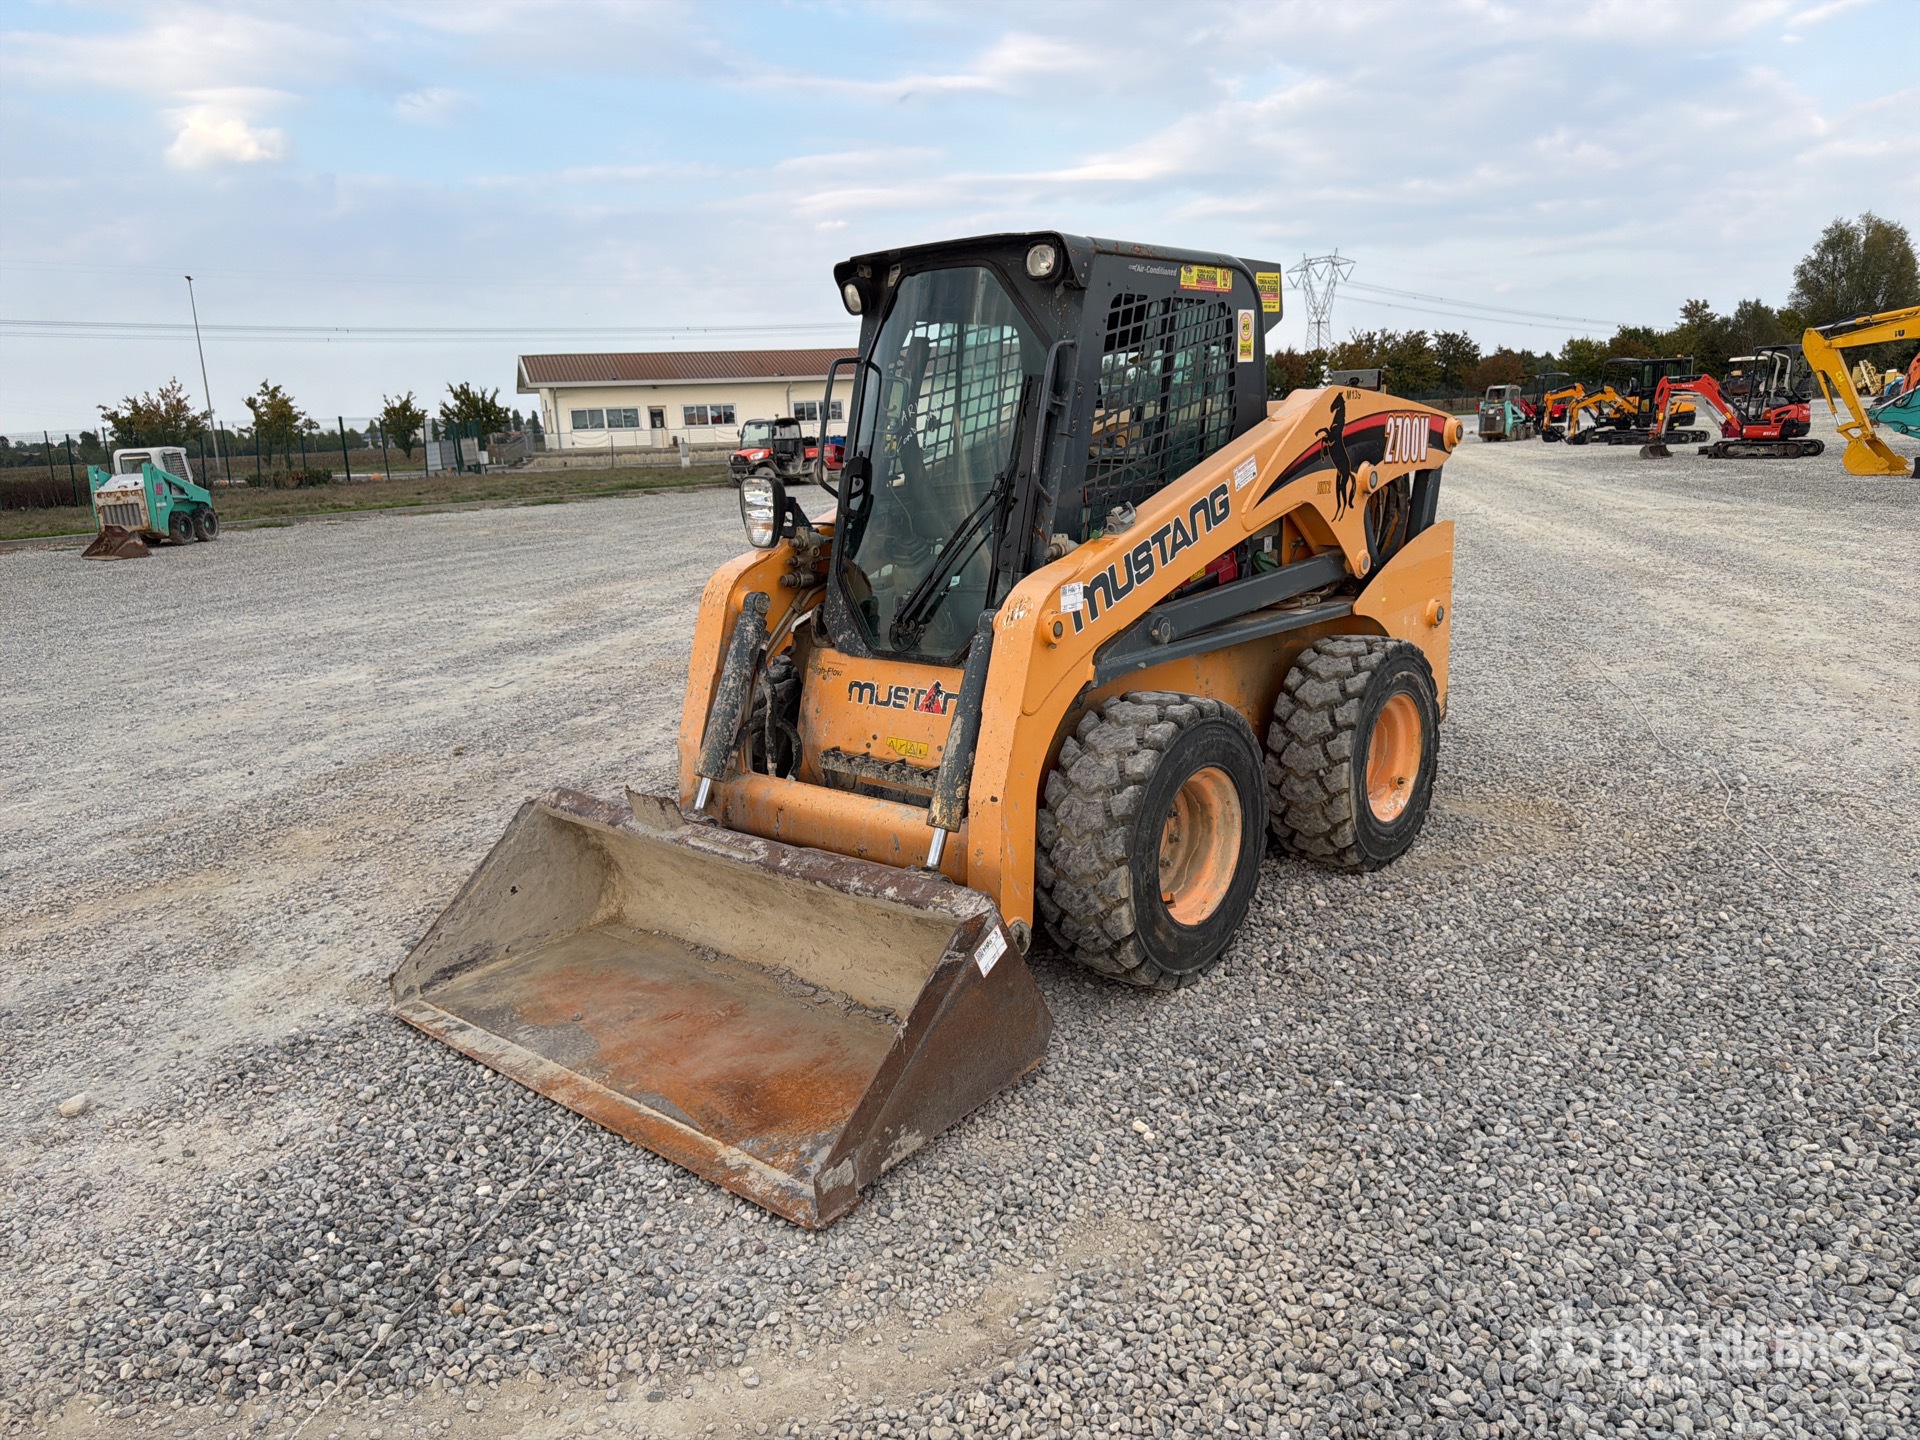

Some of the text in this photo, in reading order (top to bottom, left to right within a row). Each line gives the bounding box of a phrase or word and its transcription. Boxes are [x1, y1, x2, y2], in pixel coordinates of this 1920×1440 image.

[1136, 264, 1178, 277] Air-Conditioned
[1384, 413, 1430, 464] 2700V
[1071, 482, 1231, 634] MUSTANG
